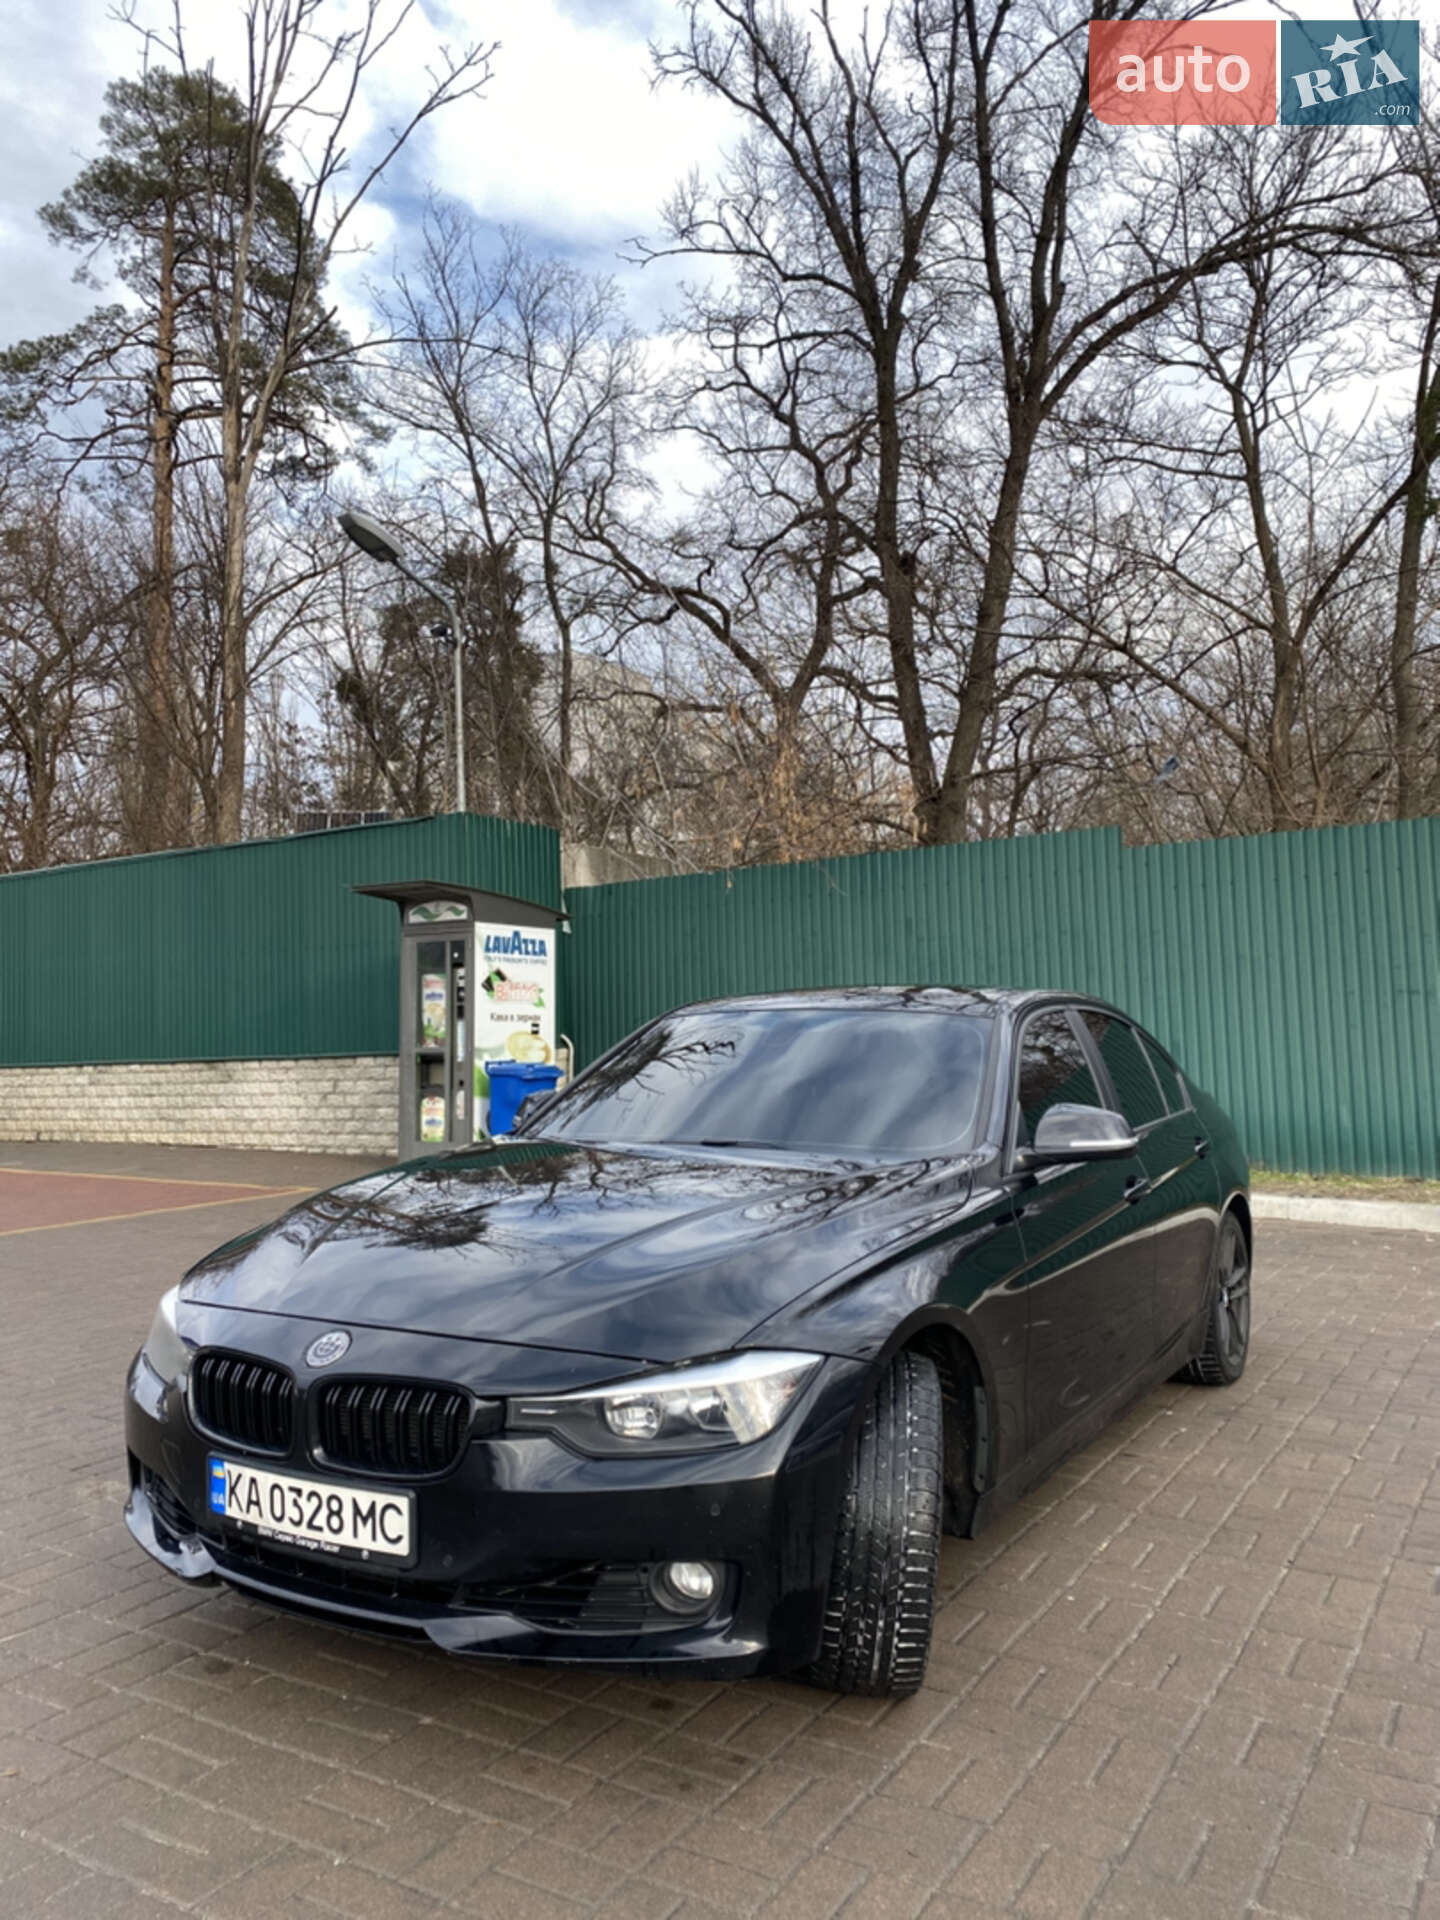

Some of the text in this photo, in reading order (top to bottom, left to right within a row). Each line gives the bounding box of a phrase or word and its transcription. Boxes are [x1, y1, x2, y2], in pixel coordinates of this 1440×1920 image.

[484, 930, 547, 957] LAVAZZA
[227, 1469, 403, 1544] KA 0328 MC
